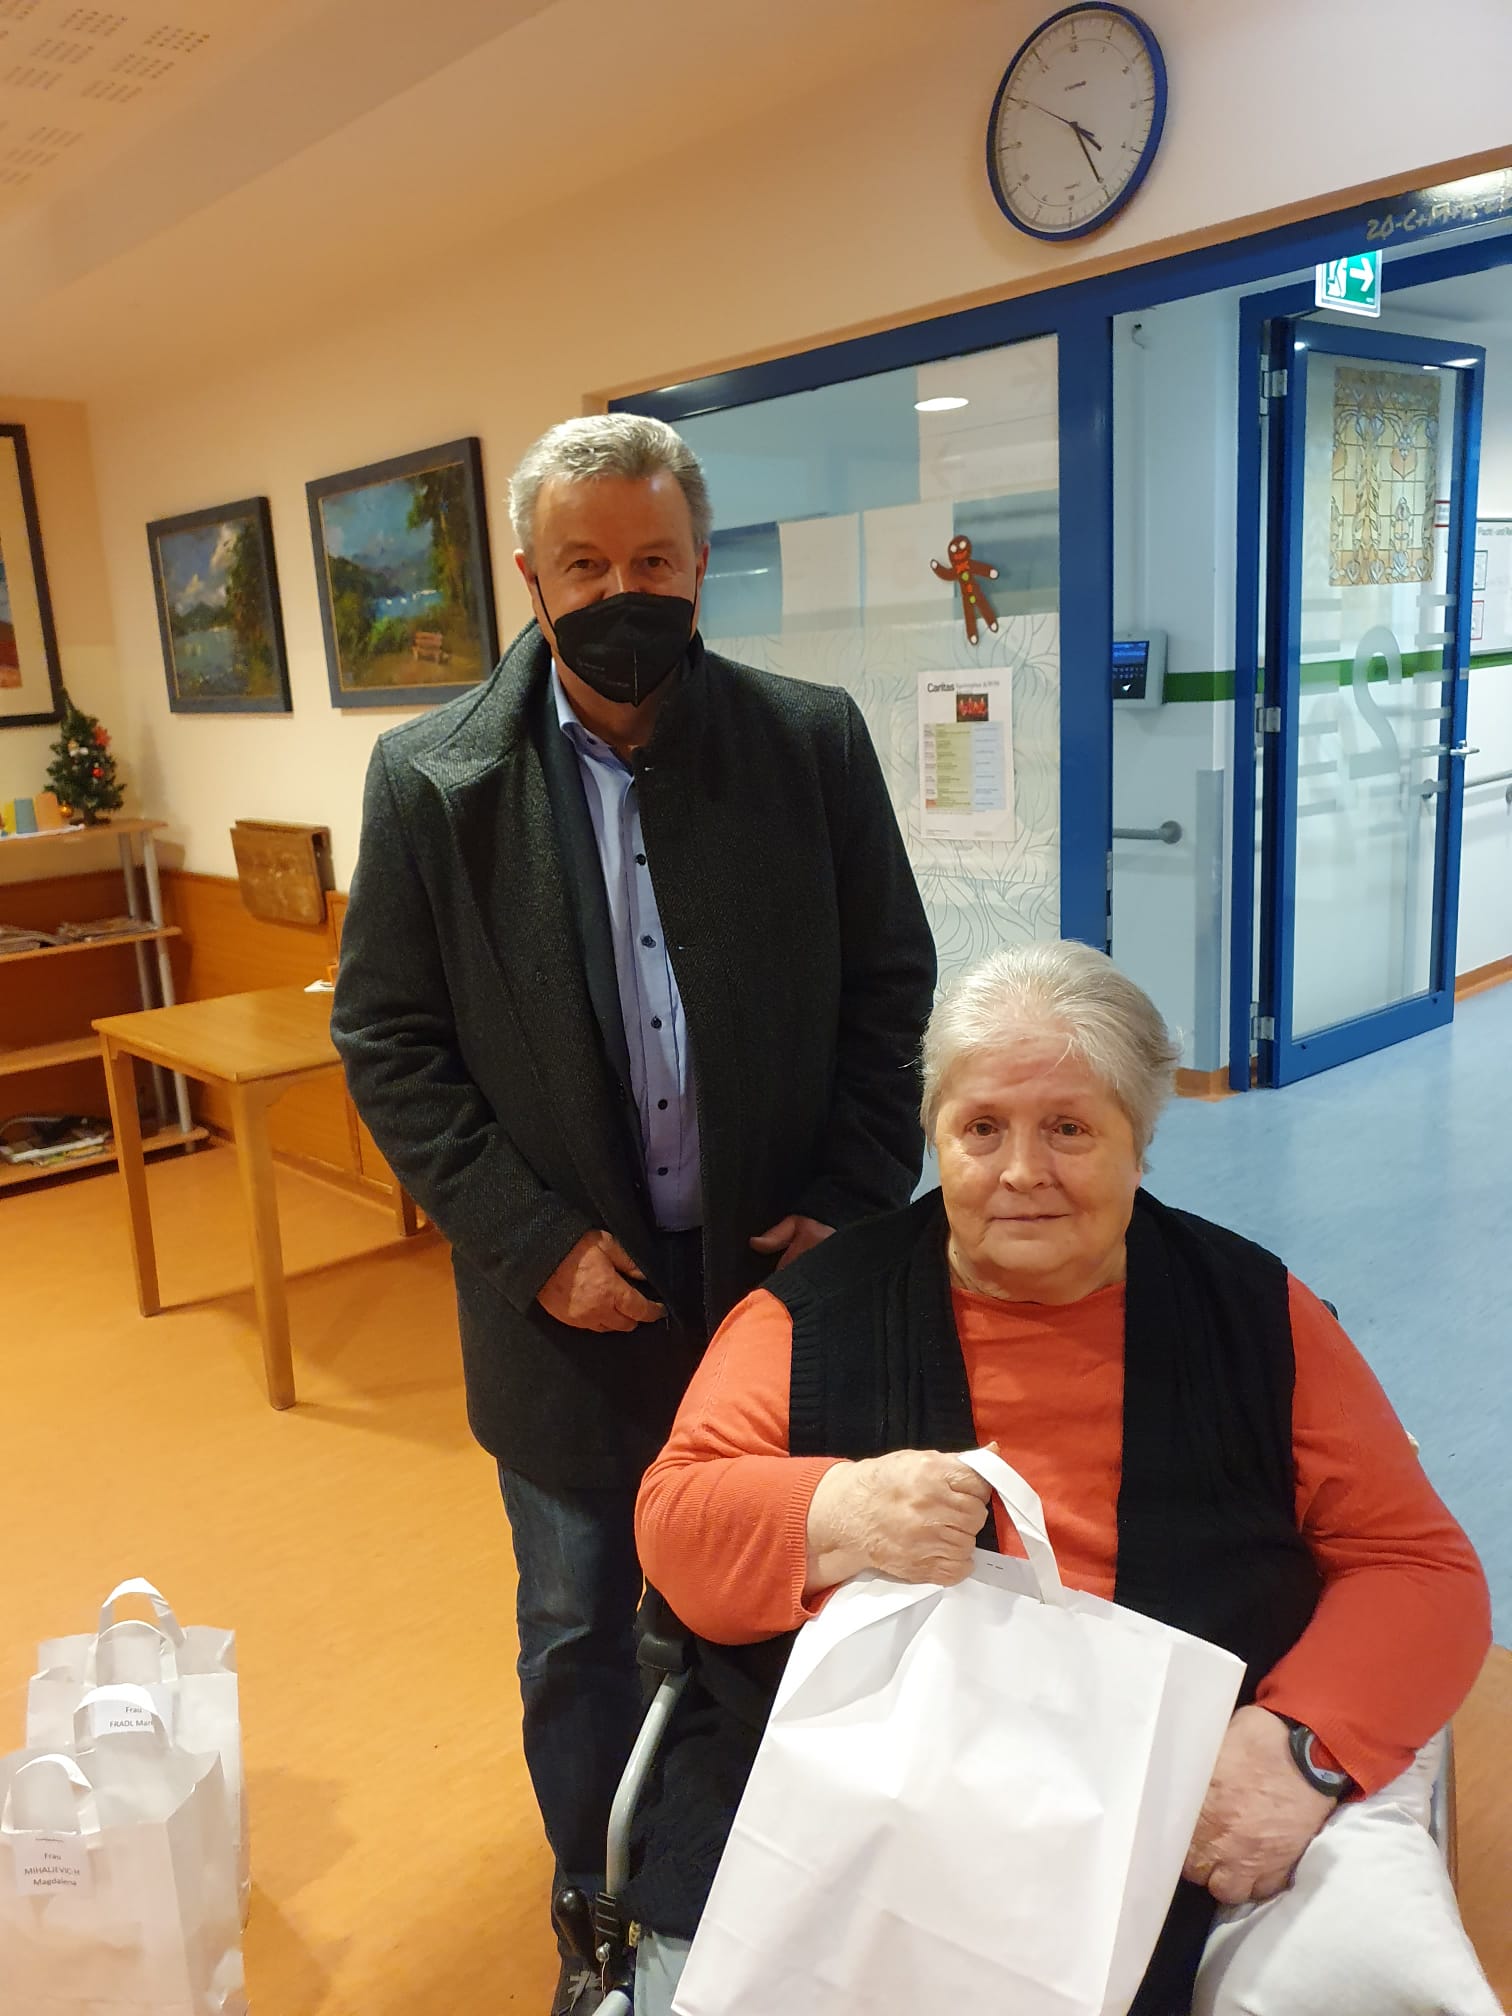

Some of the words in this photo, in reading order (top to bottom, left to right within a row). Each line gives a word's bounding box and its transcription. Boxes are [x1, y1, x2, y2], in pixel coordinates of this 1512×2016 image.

[927, 682, 955, 694] Caritas
[44, 1852, 62, 1860] Frau
[33, 1877, 77, 1886] Magdalena
